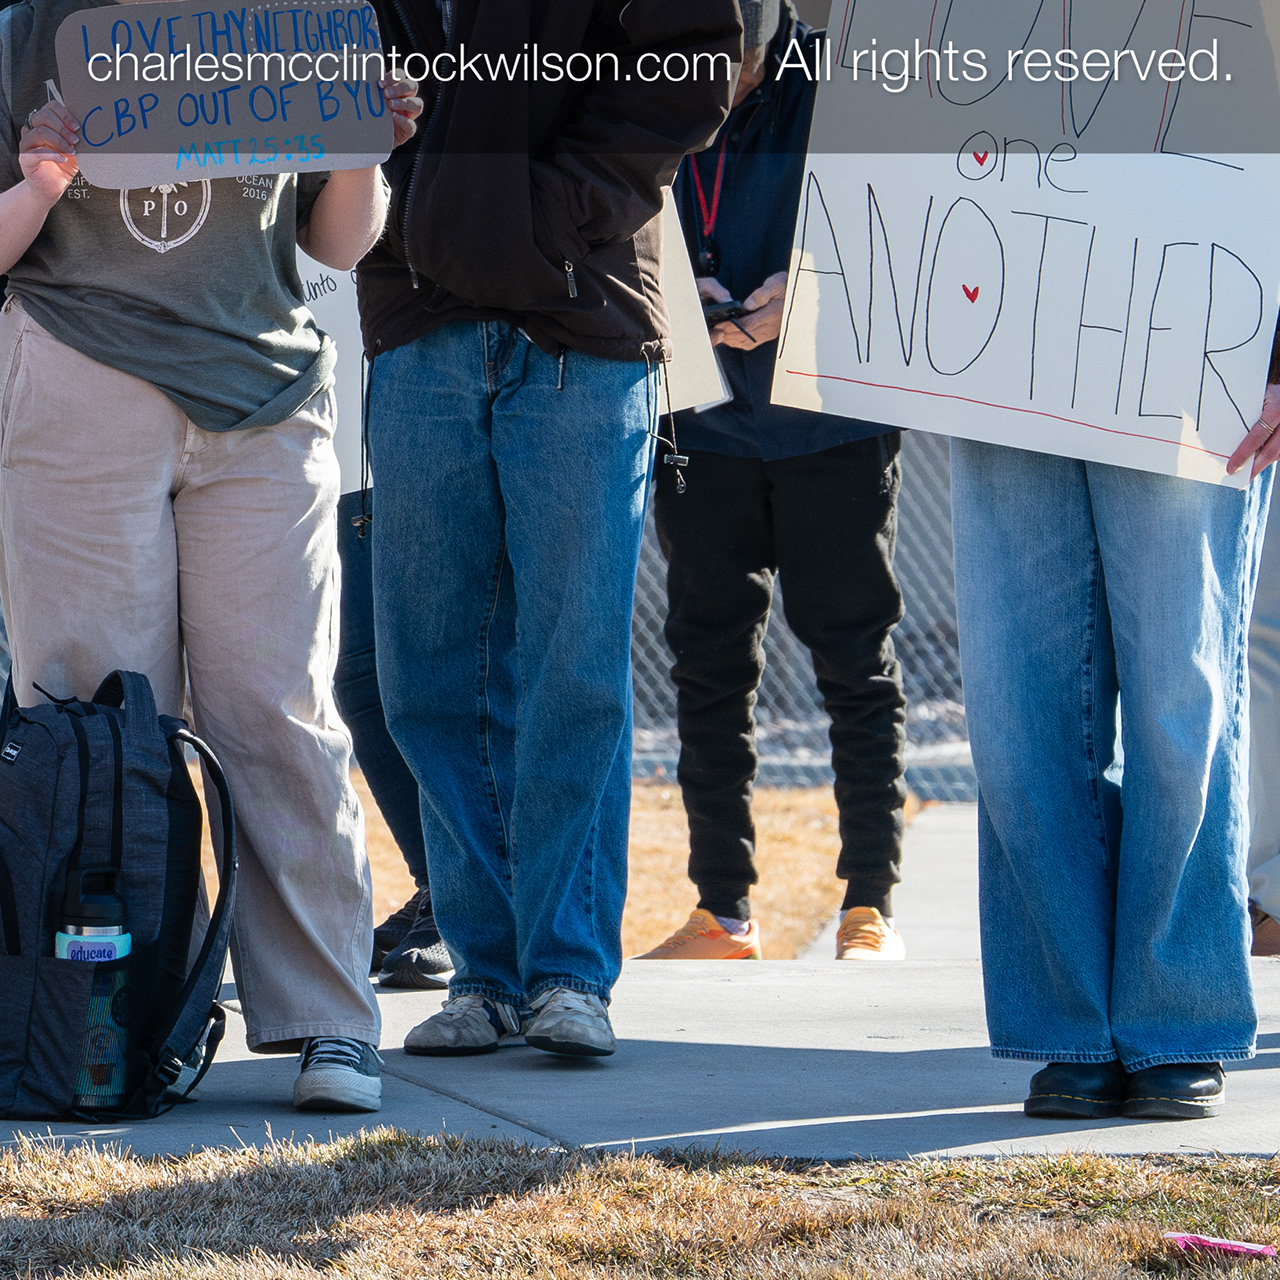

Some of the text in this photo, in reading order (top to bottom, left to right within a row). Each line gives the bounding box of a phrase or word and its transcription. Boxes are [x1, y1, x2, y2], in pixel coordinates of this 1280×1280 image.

[81, 5, 379, 63] LOVE THY NEIGHBOR
[81, 93, 159, 147] CBP
[178, 86, 241, 127] OUT
[249, 84, 304, 127] OF
[316, 79, 386, 122] BYU
[175, 134, 326, 170] MATT 25:35
[957, 130, 1089, 194] one
[67, 188, 90, 200] EST.
[236, 175, 274, 189] OCEAN
[242, 187, 268, 201] 2016
[142, 200, 188, 216] P O
[779, 171, 1263, 432] ANOTHER
[70, 945, 114, 961] educate
